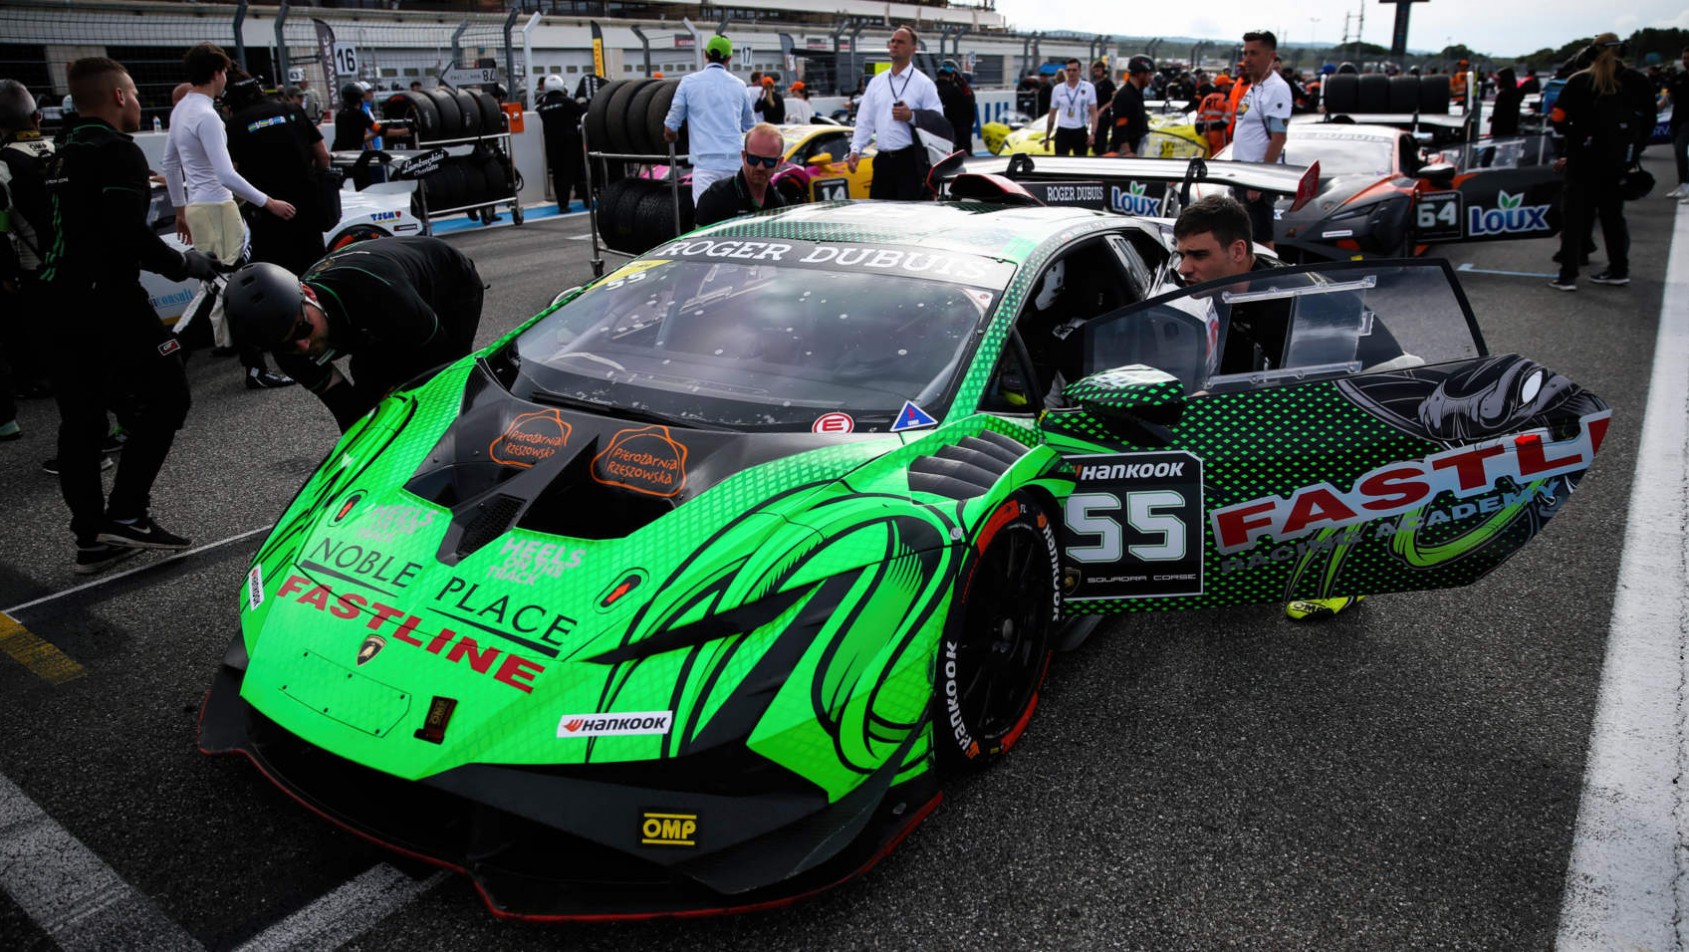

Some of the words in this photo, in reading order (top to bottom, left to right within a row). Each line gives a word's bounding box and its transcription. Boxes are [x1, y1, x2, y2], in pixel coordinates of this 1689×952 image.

[337, 48, 356, 73] 16
[742, 47, 751, 64] 17
[401, 151, 444, 174] Lamborghini
[822, 185, 846, 200] 14
[1046, 186, 1075, 201] ROGER
[1076, 186, 1104, 201] DUBUIS
[1112, 185, 1161, 217] LOUX
[1417, 201, 1457, 228] 64
[1468, 203, 1552, 236] LOUX
[654, 240, 792, 261] ROGER
[800, 245, 992, 279] DUBUIS
[605, 270, 647, 291] 55
[369, 503, 440, 527] HEELS
[1064, 490, 1187, 563] 55
[1220, 531, 1363, 574] RACING
[1373, 479, 1561, 539] ACADEMY
[308, 537, 424, 588] NOBLE
[500, 537, 587, 568] HEELS
[487, 565, 541, 586] TRACK
[503, 556, 531, 571] ON
[531, 560, 566, 579] THE
[1087, 575, 1147, 584] SQUADRA
[1153, 573, 1197, 581] CORSE
[434, 577, 578, 646] PLACE
[276, 575, 546, 694] FASTLINE
[643, 818, 697, 840] OMP
